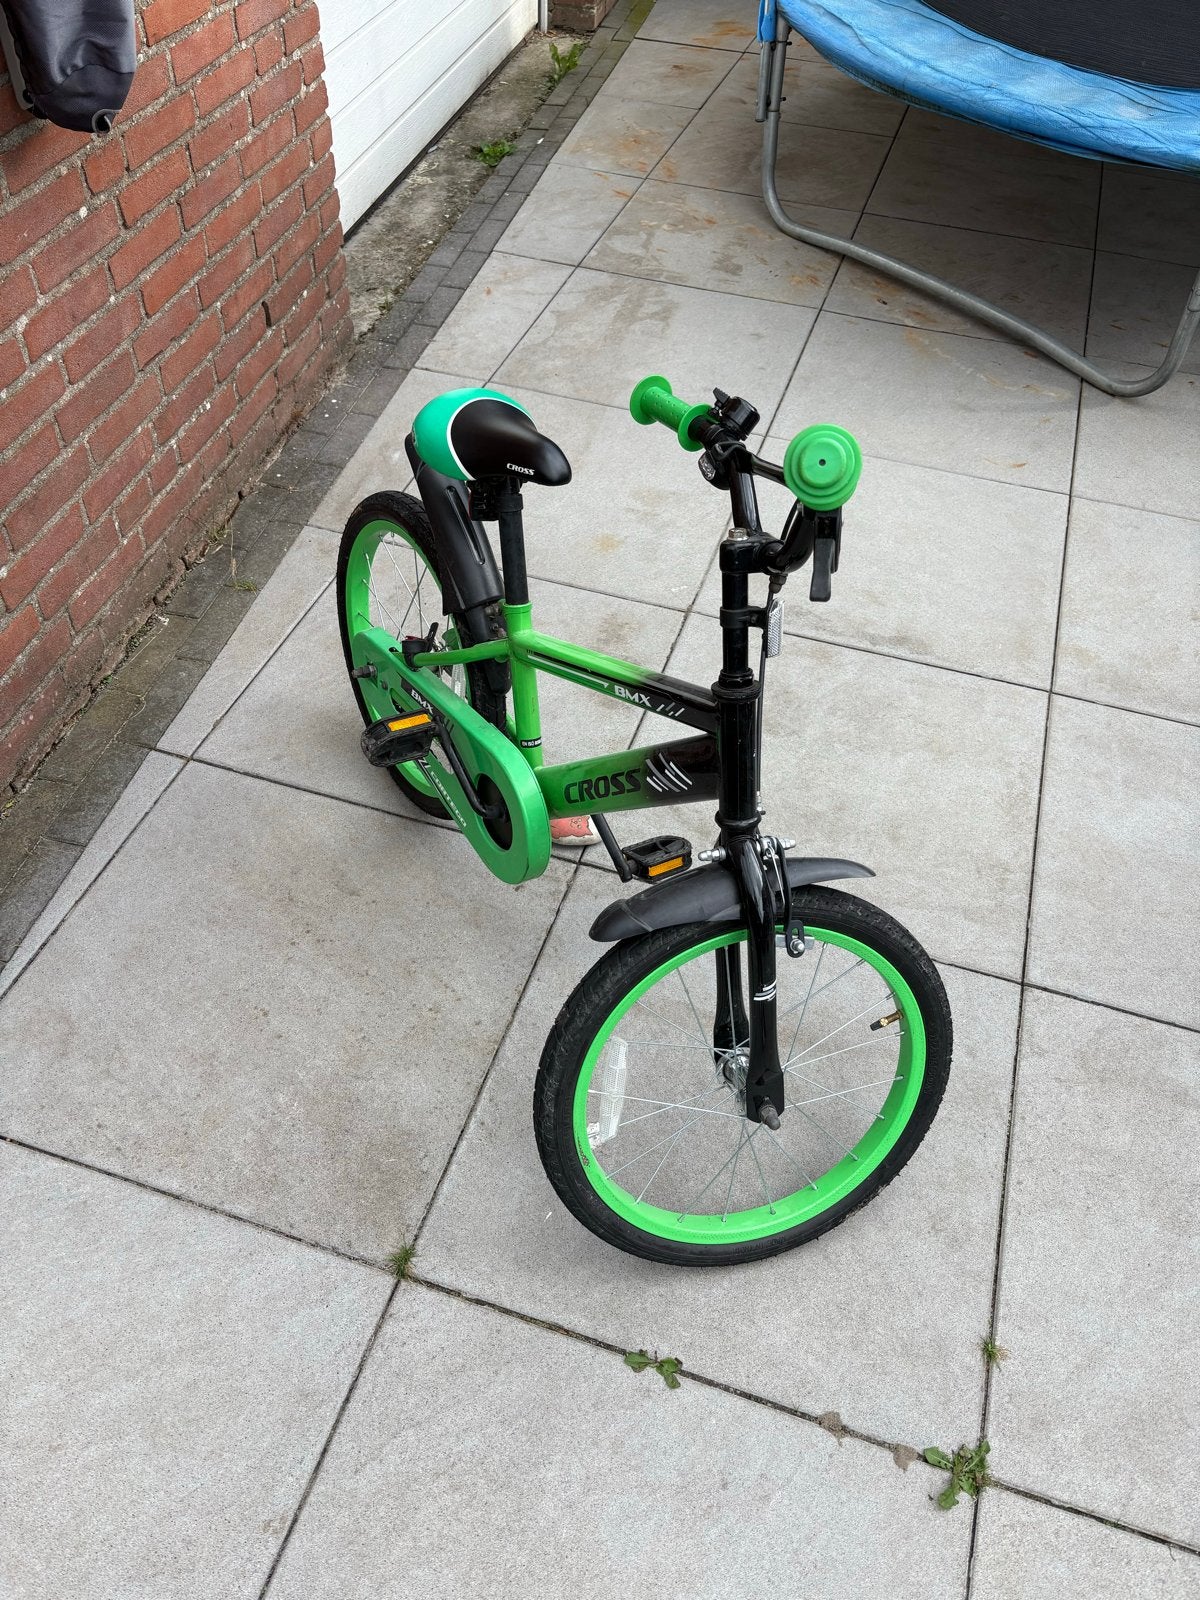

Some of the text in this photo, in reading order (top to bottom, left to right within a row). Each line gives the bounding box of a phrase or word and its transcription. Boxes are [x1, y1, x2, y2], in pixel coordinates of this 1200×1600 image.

[506, 462, 535, 476] CROSS
[411, 688, 434, 715] BMX
[614, 684, 652, 708] BMX
[563, 767, 642, 804] CROSS
